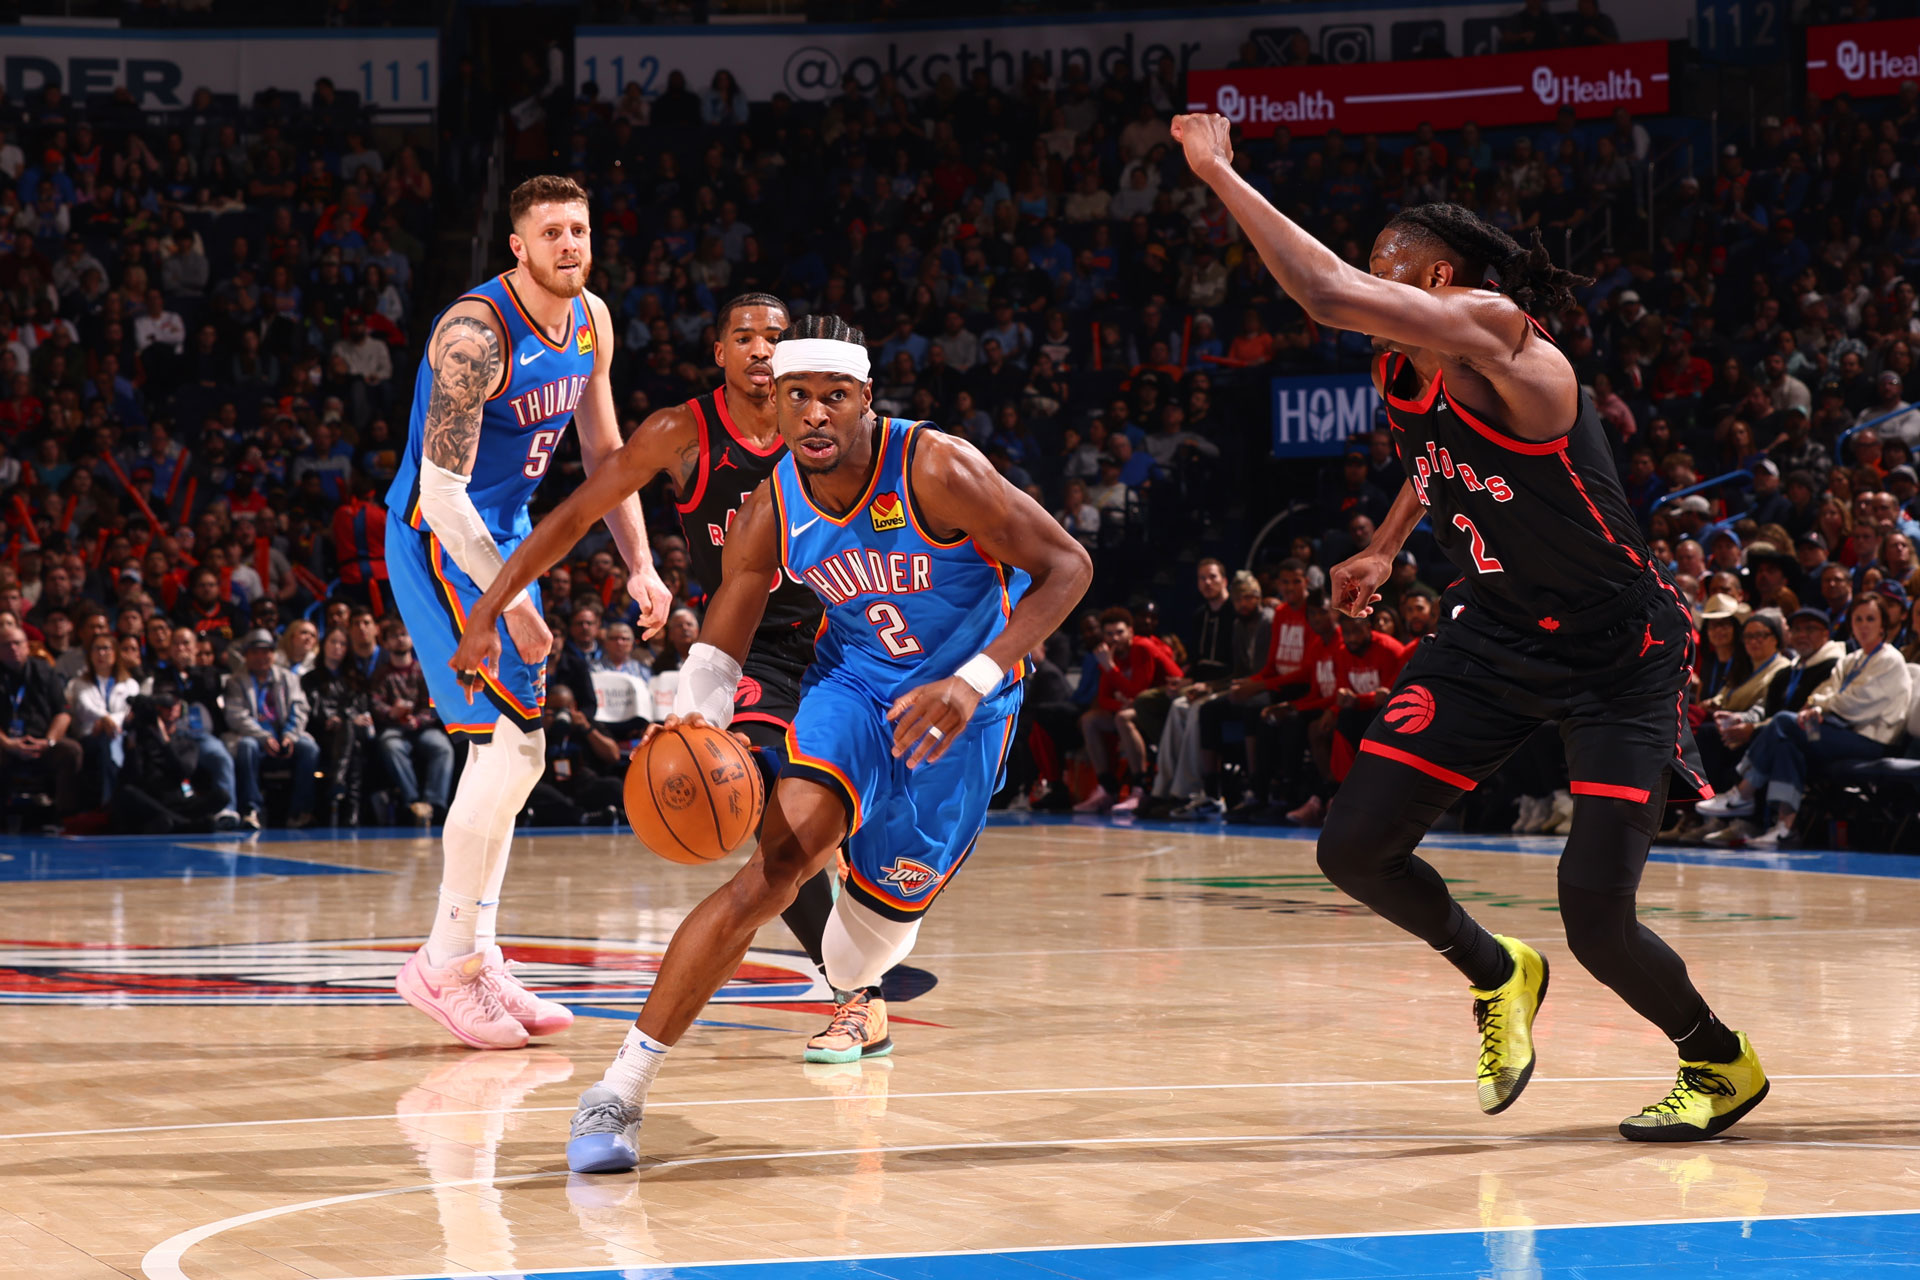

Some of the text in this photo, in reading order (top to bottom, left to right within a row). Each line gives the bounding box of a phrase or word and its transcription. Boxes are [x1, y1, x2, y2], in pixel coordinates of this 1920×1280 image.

[1701, 2, 1776, 49] 112
[358, 60, 430, 101] 111
[584, 55, 661, 98] 112
[1561, 68, 1643, 105] Health
[1248, 89, 1335, 124] Health
[508, 375, 590, 429] THUNDE
[1451, 512, 1505, 575] 2
[802, 548, 933, 606] HUNDER
[865, 601, 925, 660] 2
[887, 868, 929, 882] OKC
